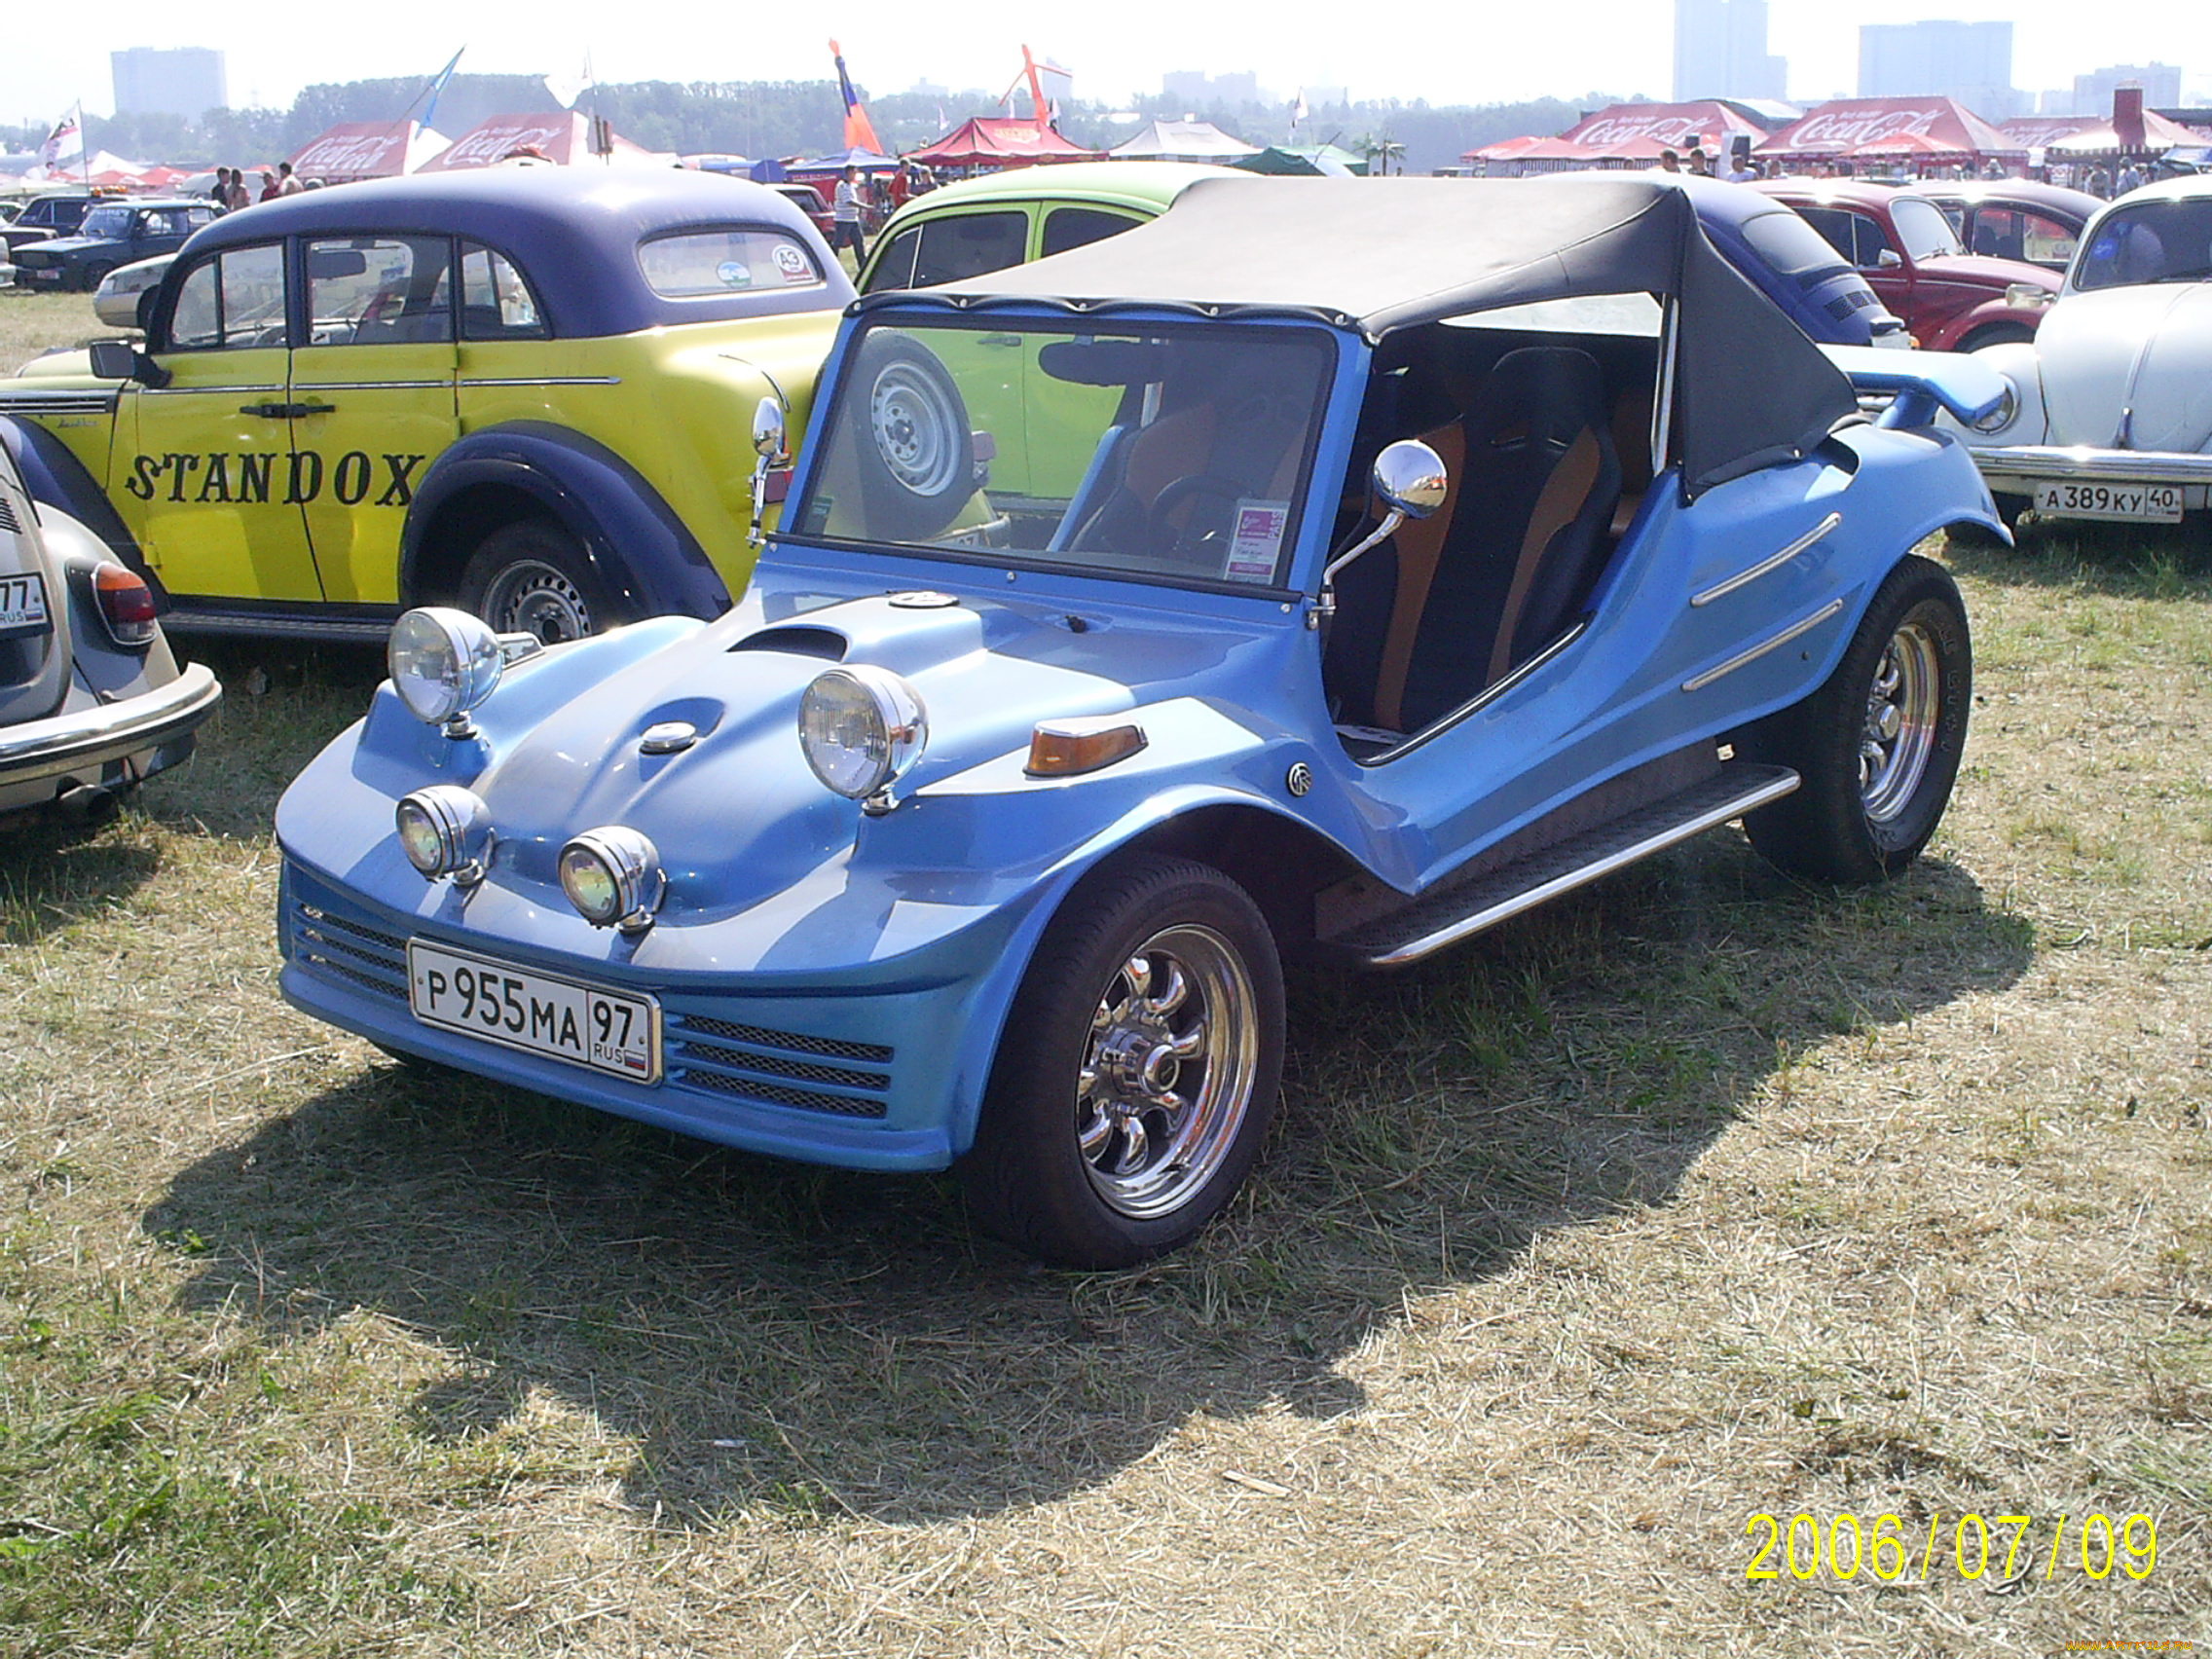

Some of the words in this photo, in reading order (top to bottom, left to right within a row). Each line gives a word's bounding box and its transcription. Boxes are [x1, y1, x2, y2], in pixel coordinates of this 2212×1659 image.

[125, 451, 425, 506] STANDOX
[2149, 490, 2174, 507] 40
[1267, 511, 1284, 539] PASS
[0, 580, 28, 611] 77
[593, 1000, 632, 1048] 97
[593, 1042, 623, 1064] RUS
